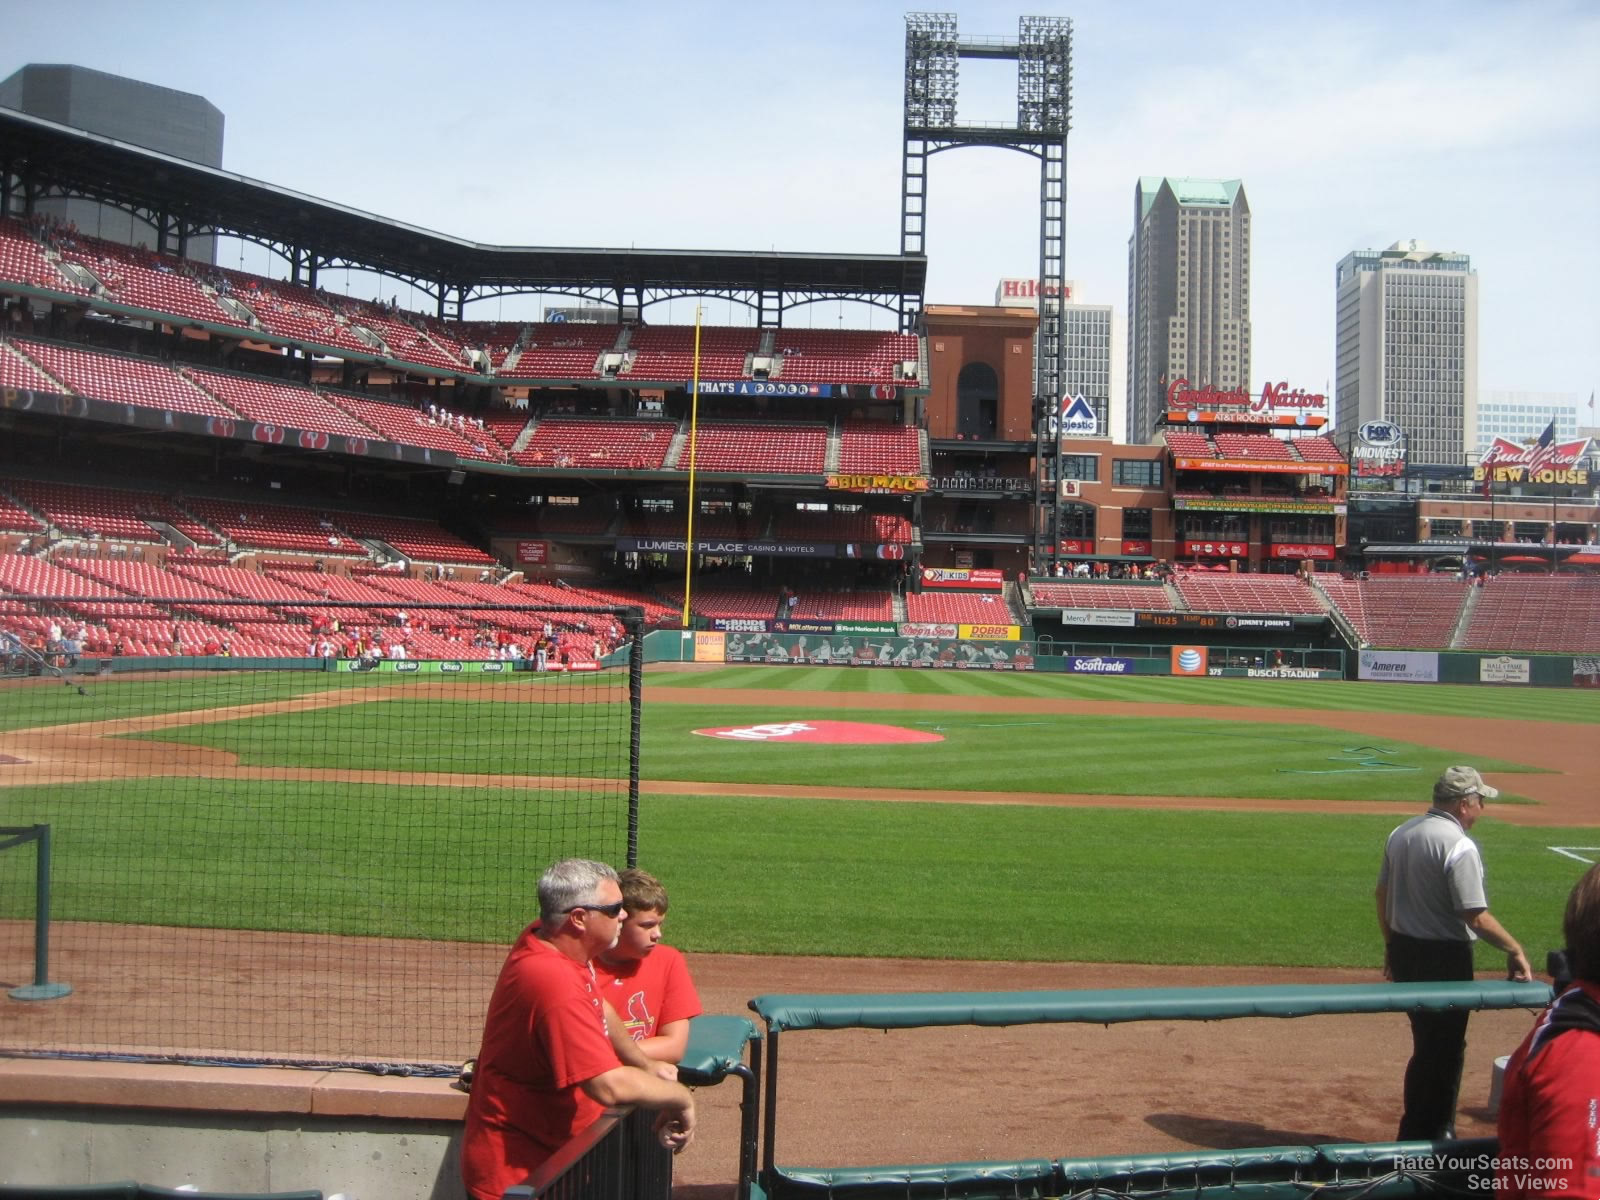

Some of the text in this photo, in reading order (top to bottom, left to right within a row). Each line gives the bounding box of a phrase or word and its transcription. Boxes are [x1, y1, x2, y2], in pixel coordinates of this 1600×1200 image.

[699, 382, 734, 393] THAT'S
[741, 383, 748, 393] A
[1168, 378, 1326, 411] Cardinals Nation
[1214, 413, 1280, 423] AT&T ROOFTOP
[1367, 425, 1393, 438] FOX
[1353, 446, 1406, 459] MIDWEST
[839, 475, 917, 490] BIG MAC
[699, 543, 743, 552] PLACE
[715, 618, 766, 626] McBRIDE
[1066, 615, 1086, 624] Mercy
[1153, 617, 1177, 625] 11:25
[1238, 619, 1264, 627] JIMMY
[971, 626, 1008, 635] DOBBS
[1073, 657, 1125, 672] Scottrade
[1371, 661, 1406, 672] Ameren
[1248, 669, 1319, 679] BUSCH STADIUM
